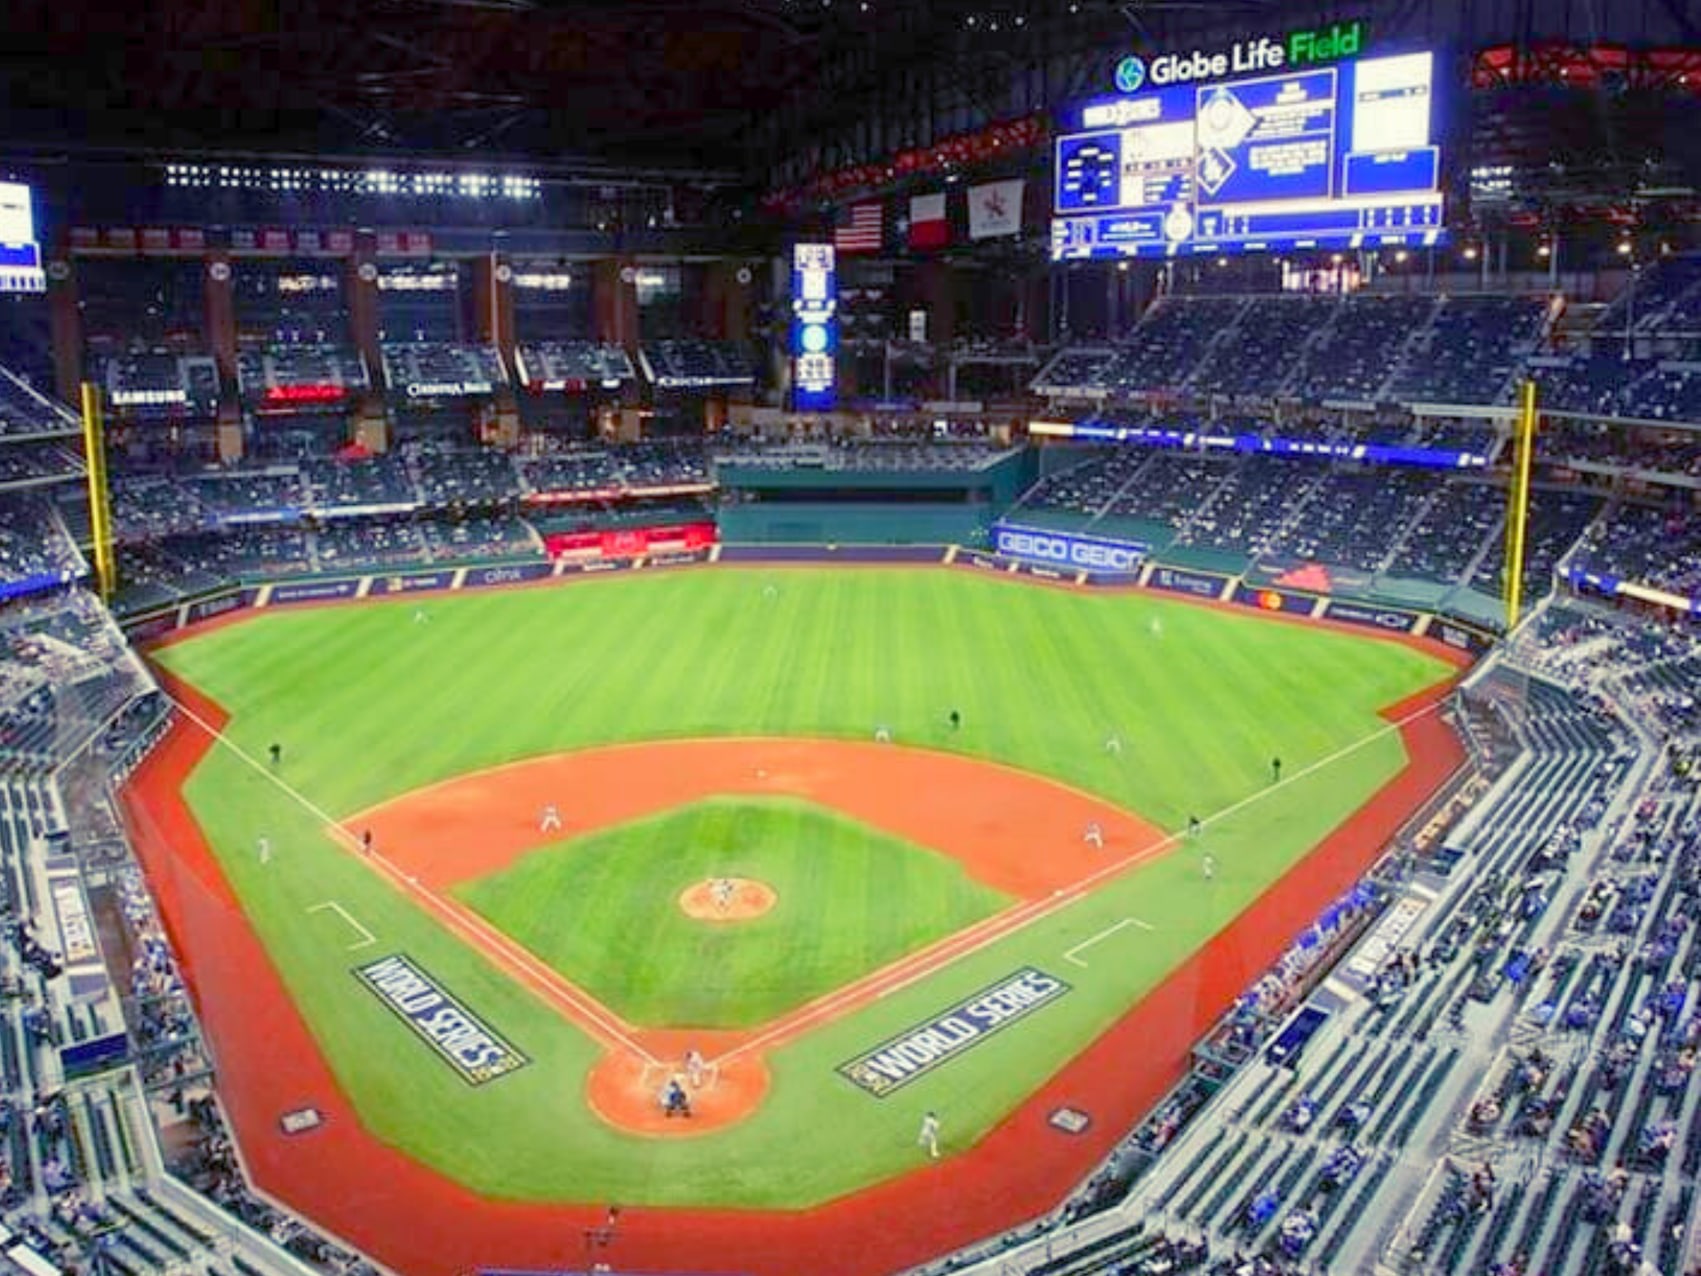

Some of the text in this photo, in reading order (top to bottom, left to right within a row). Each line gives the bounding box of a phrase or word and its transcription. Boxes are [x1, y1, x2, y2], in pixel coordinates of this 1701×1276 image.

[1150, 22, 1361, 84] Globe Life Field
[998, 531, 1067, 559] GEICO
[363, 956, 505, 1068] WORLD SERIES
[865, 972, 1061, 1079] WORLD SERIES
